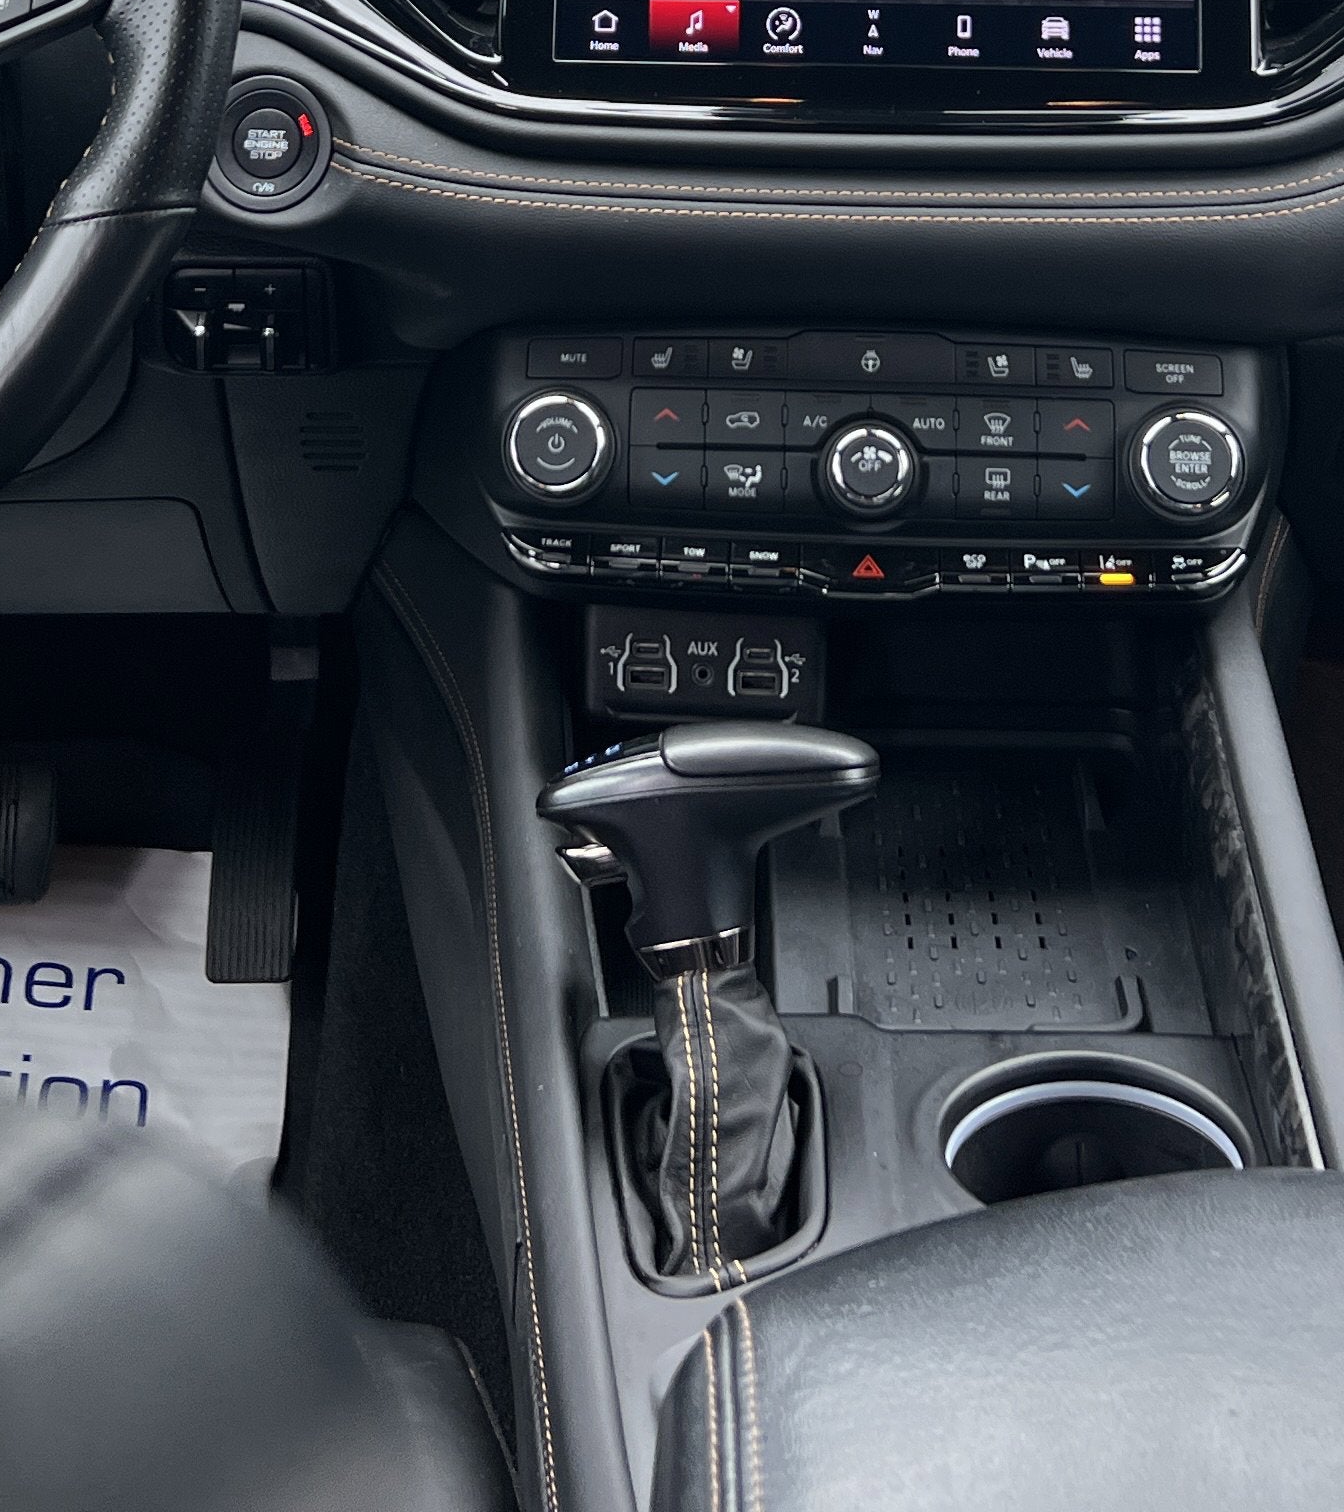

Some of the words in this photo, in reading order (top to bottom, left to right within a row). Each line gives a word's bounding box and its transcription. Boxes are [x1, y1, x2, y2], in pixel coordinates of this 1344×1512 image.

[590, 40, 619, 51] Home
[678, 42, 708, 53] Media
[763, 42, 804, 54] Comfort
[863, 44, 883, 56] Nav
[948, 46, 980, 58] Phone
[1037, 48, 1073, 60] Vehicle
[1134, 49, 1161, 62] Apps
[248, 129, 286, 139] START
[243, 140, 288, 150] ENGINE
[249, 150, 283, 160] STOP
[561, 353, 587, 363] MUTE
[1156, 364, 1194, 374] SCREEN
[1166, 375, 1184, 384] OFF
[541, 417, 573, 428] VOLUME
[805, 416, 828, 428] A/C
[913, 418, 946, 431] AUTO
[981, 436, 1014, 448] FRONT
[1179, 435, 1202, 445] TUNE
[1170, 450, 1211, 461] BROWSE
[858, 460, 882, 472] OFF
[1175, 464, 1208, 474] ENTER
[1175, 477, 1207, 490] SCROLL
[728, 486, 757, 497] MODE
[984, 491, 1010, 501] REAR
[542, 538, 572, 548] TRACK
[610, 544, 641, 554] SPORT
[683, 547, 706, 558] TOW
[749, 550, 779, 561] SNOW
[688, 641, 718, 656] AUX
[609, 662, 615, 675] 1
[791, 669, 800, 683] 2
